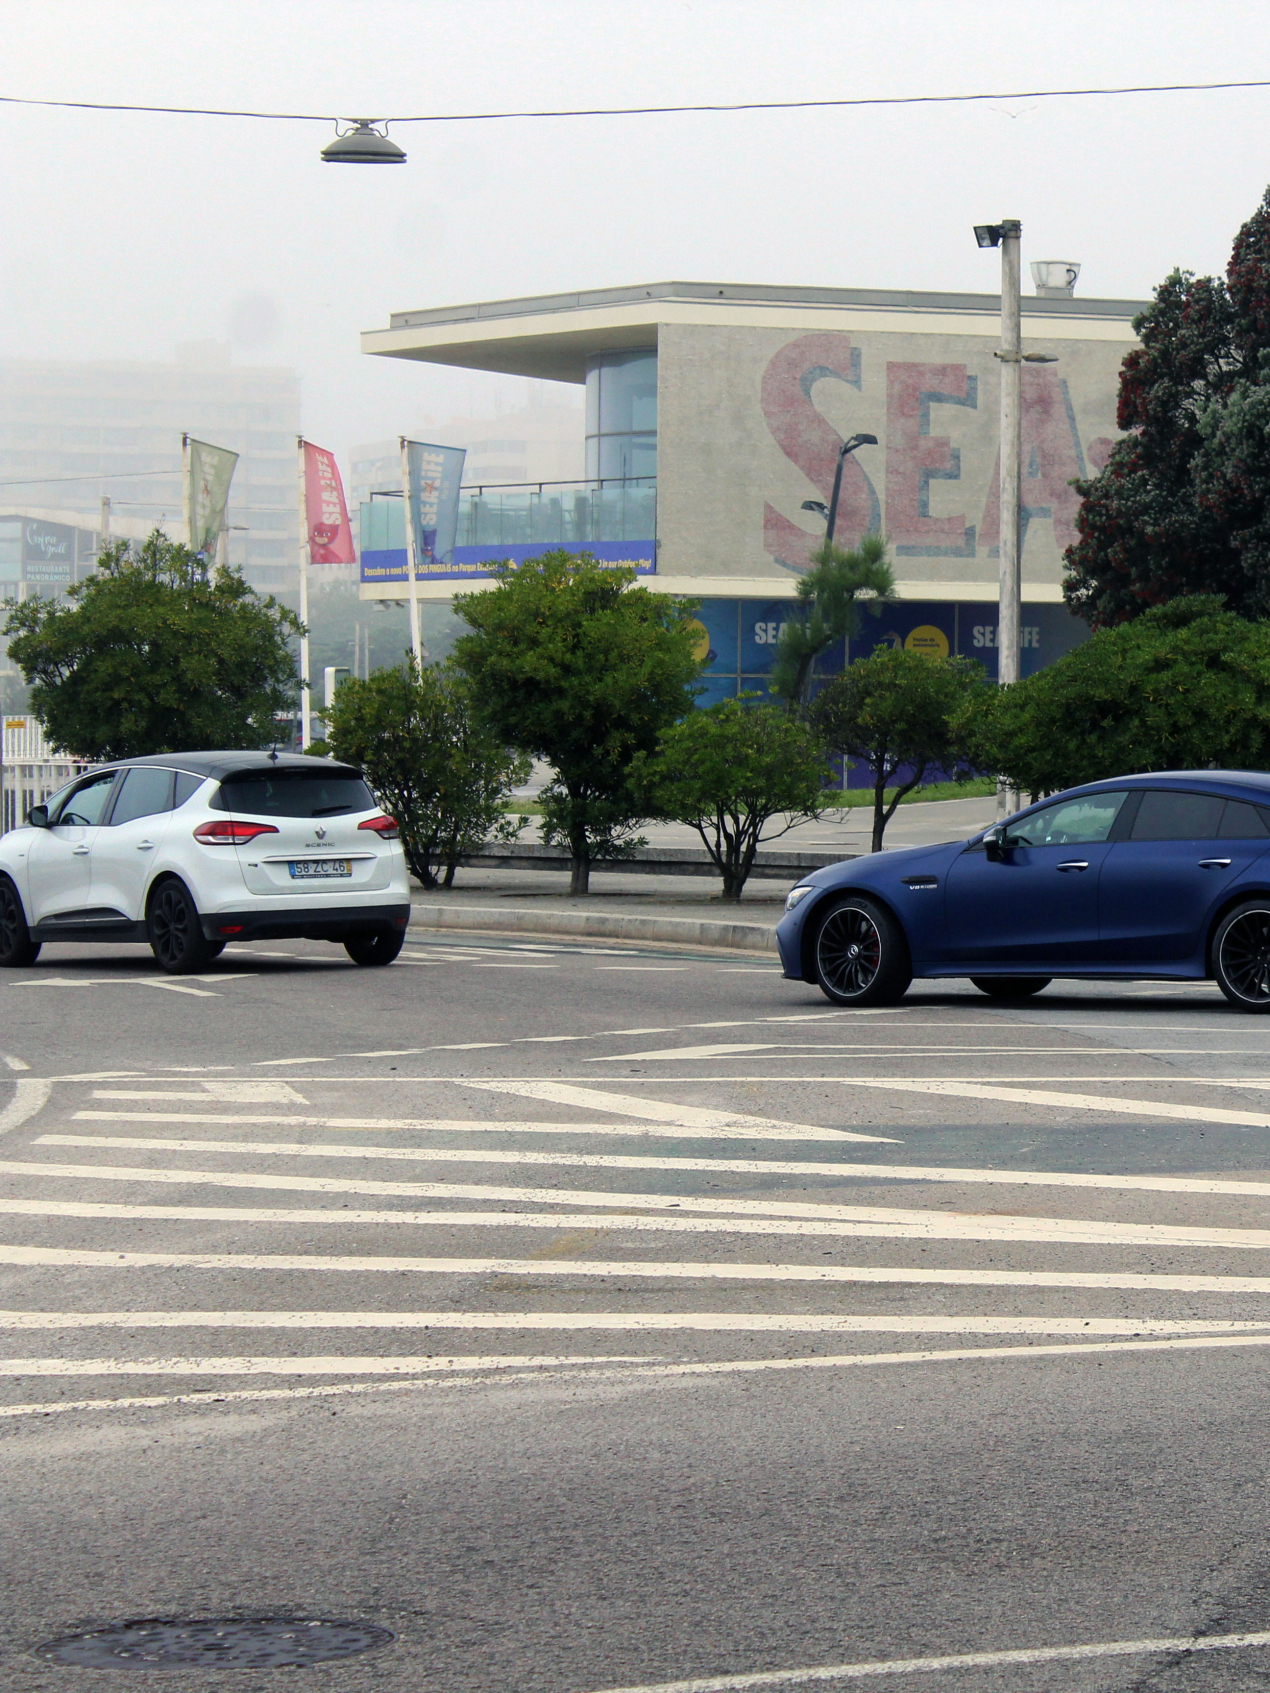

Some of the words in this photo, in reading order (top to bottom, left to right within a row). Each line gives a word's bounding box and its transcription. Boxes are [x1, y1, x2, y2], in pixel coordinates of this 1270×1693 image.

[322, 491, 342, 525] SEA
[421, 490, 439, 526] SEA
[26, 564, 71, 573] RESTAURANTE
